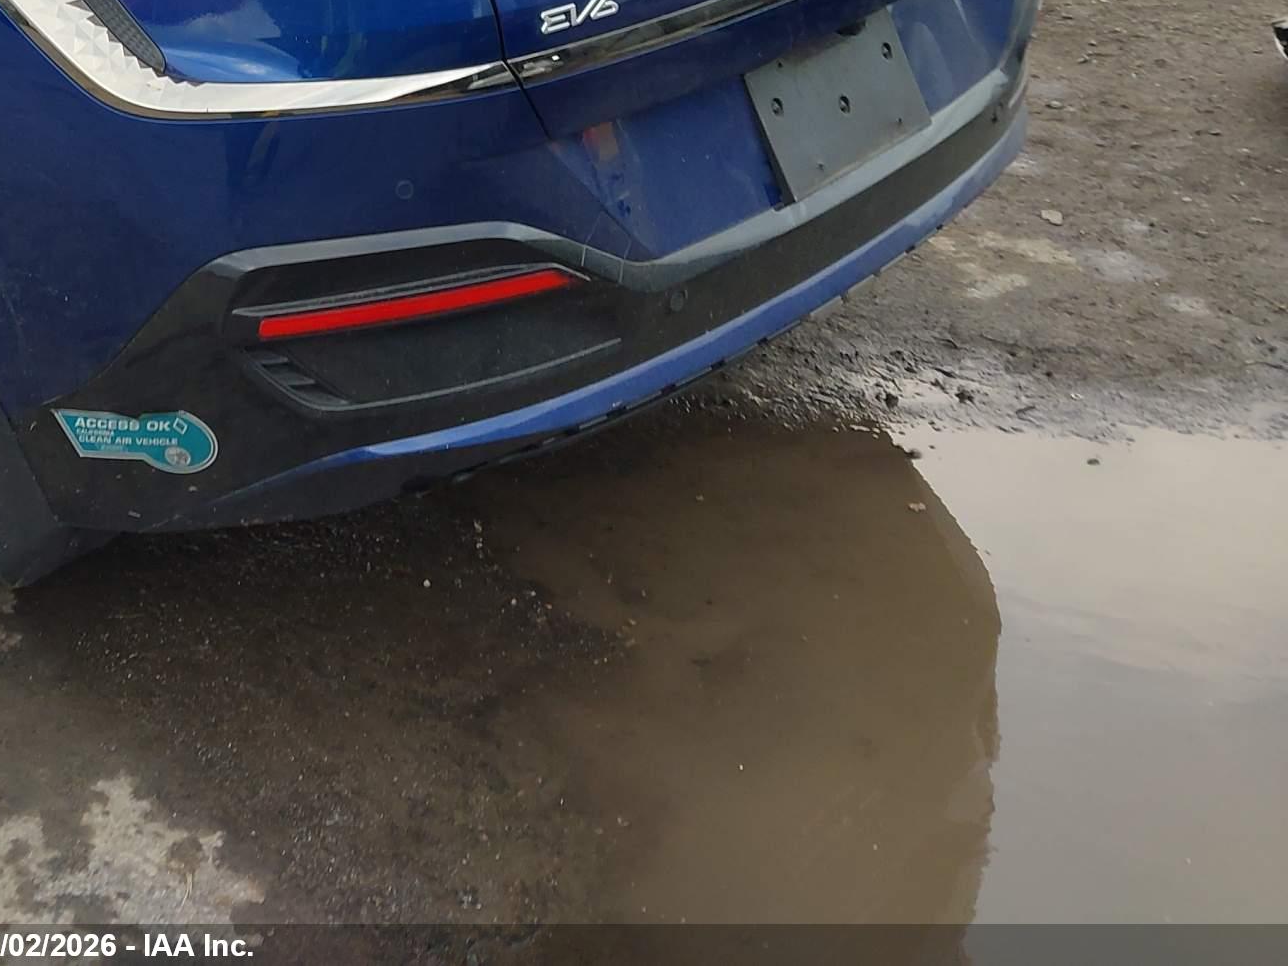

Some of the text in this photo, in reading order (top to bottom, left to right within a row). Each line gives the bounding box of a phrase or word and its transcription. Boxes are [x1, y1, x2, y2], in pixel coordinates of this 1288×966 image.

[74, 417, 171, 432] ACCESS OK
[78, 435, 179, 447] CLEAN AIR VEHICLE
